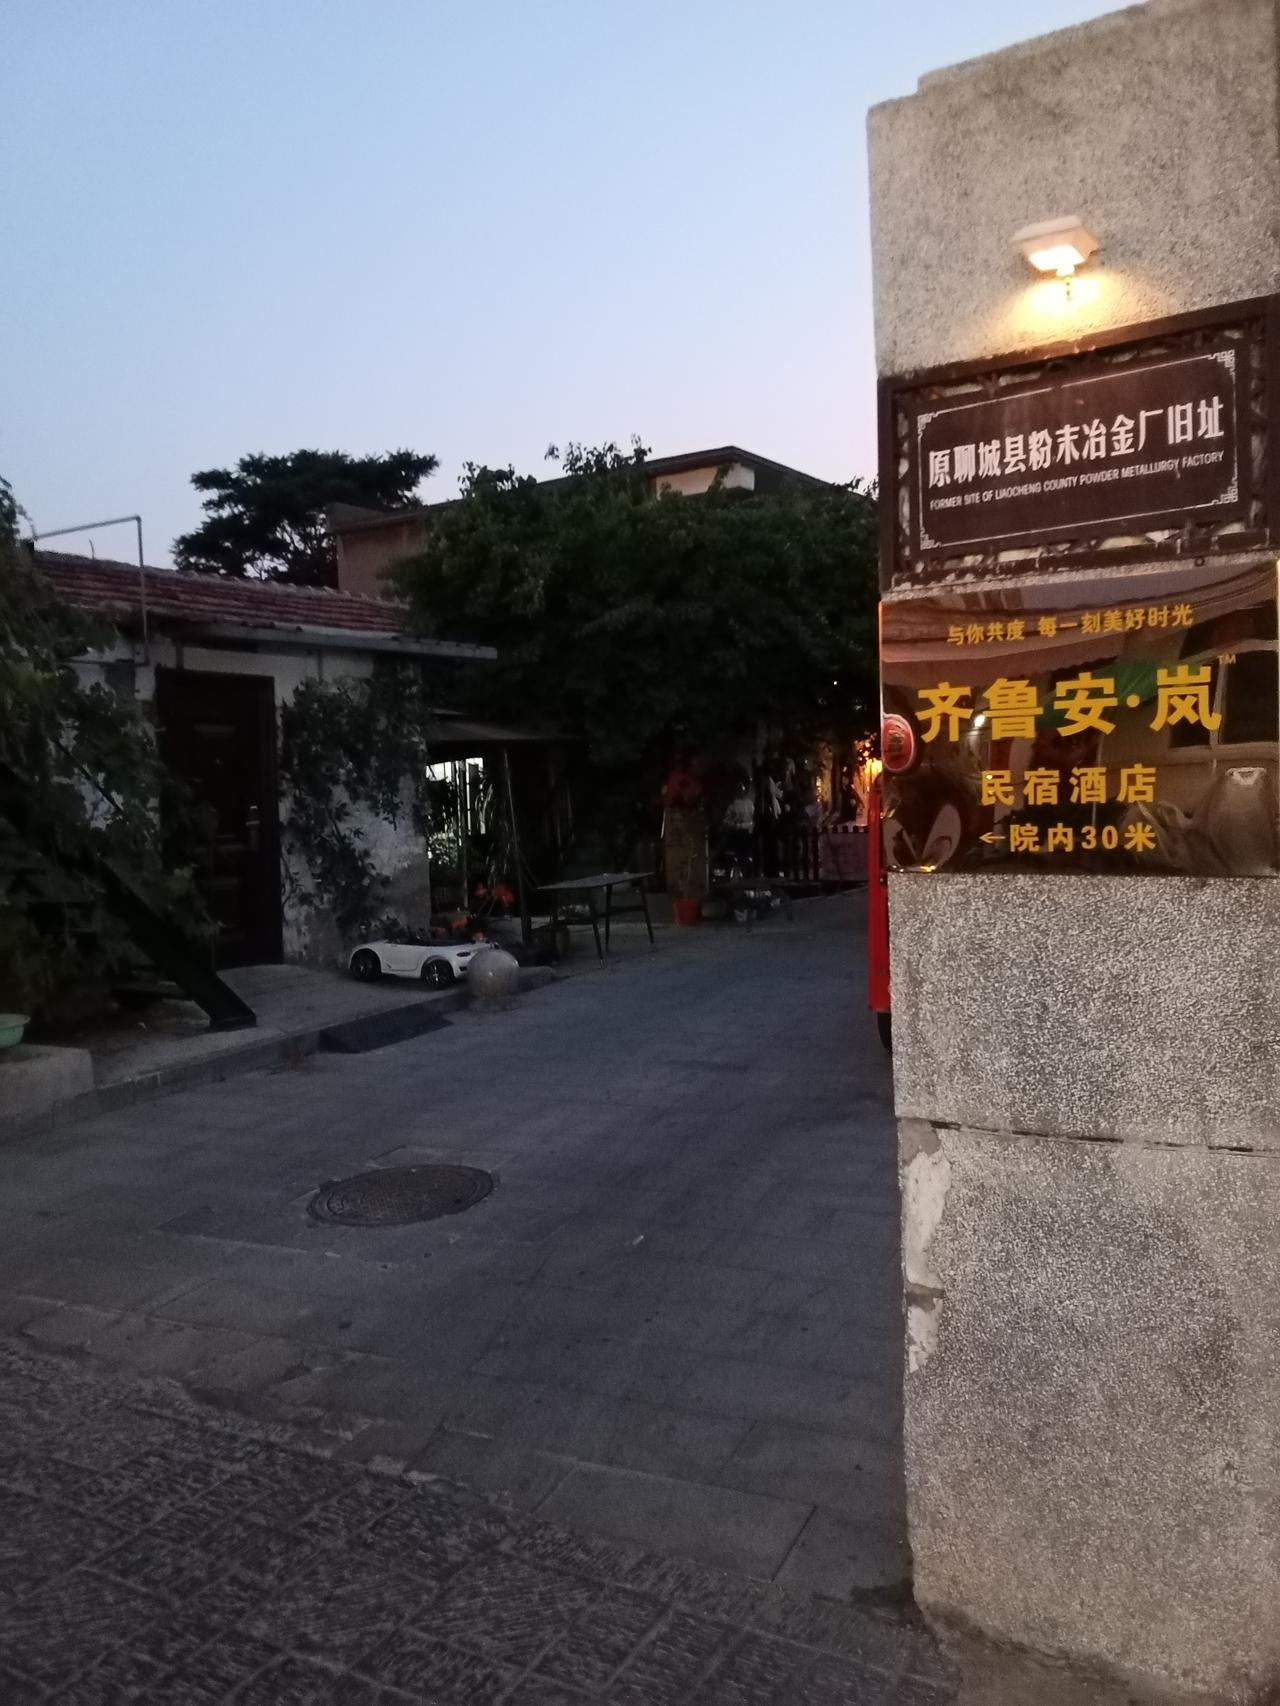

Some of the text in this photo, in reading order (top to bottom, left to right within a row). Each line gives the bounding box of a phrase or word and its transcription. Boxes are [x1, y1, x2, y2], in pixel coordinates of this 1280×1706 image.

[928, 396, 1225, 488] 原聊城县粉末冶金厂旧址
[930, 450, 1224, 511] FORMER SITE OF LIAOCHENG COUNTY POWDER METALLURGY FACTORY
[947, 603, 1194, 645] 与你共度 每一刻美好时光
[980, 763, 1157, 806] 民宿酒店
[1009, 823, 1157, 852] 院内30米
